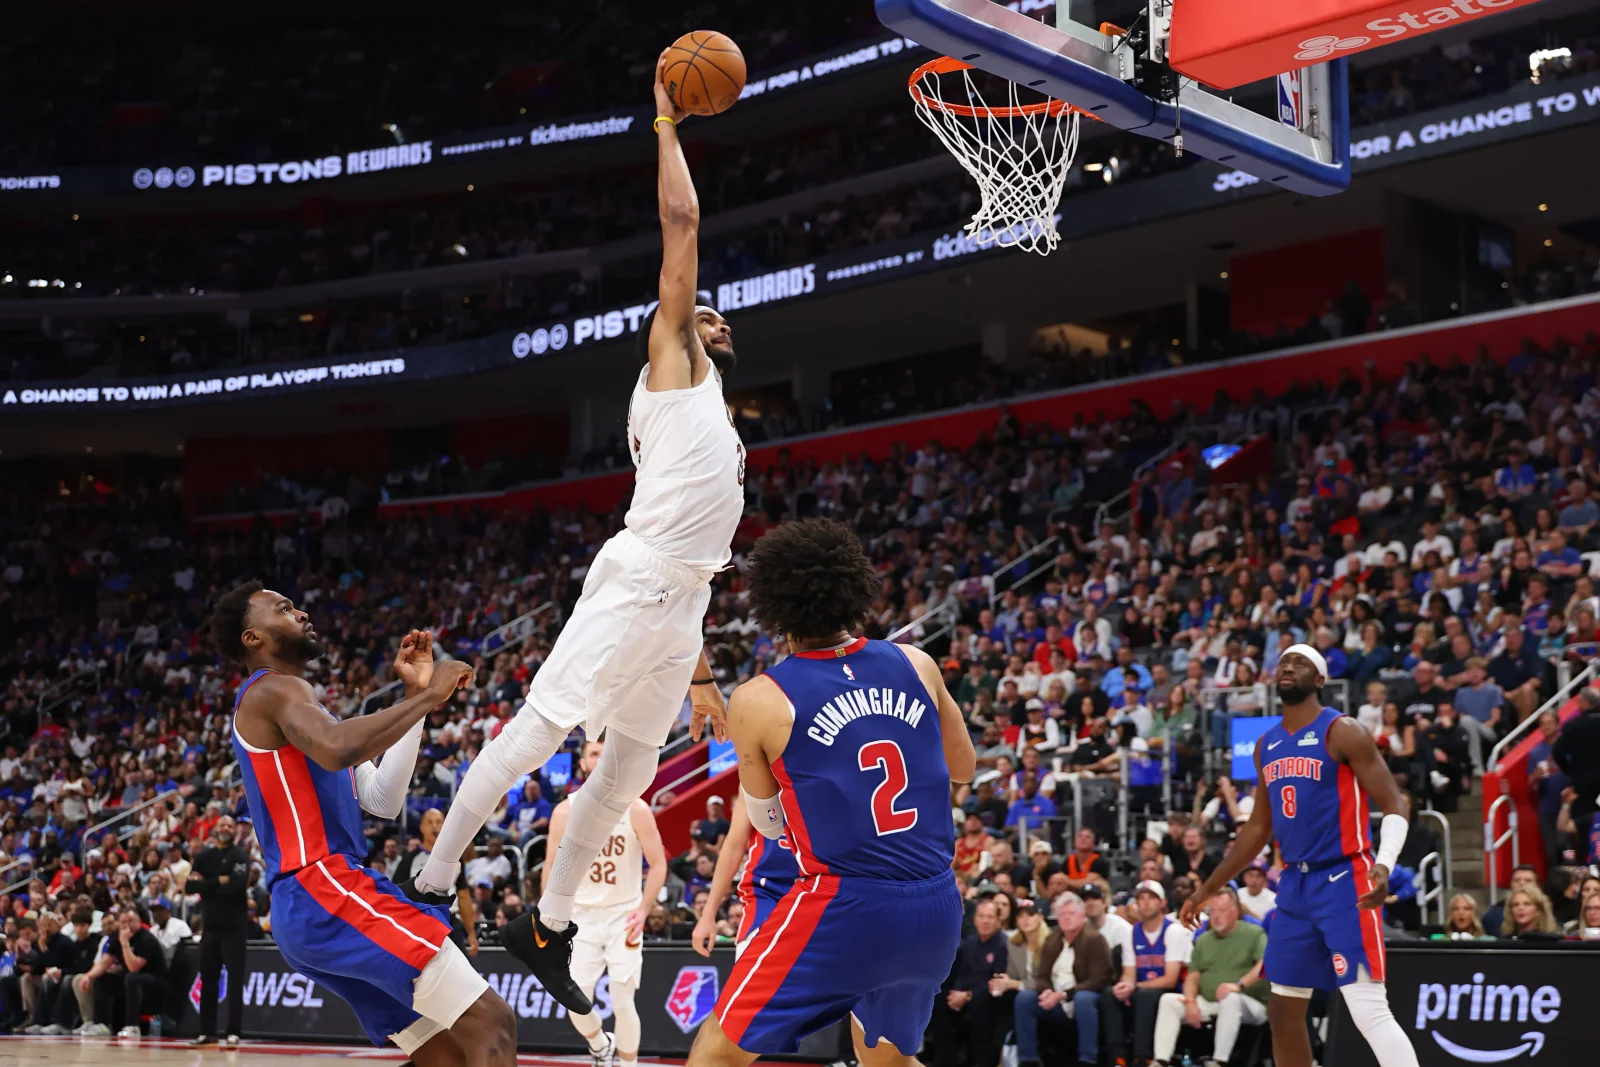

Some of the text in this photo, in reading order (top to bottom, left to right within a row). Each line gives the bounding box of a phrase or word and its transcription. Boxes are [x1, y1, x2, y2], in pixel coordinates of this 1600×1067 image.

[768, 69, 799, 91] FOR
[800, 66, 813, 82] A
[813, 45, 879, 77] CHANCE
[879, 37, 904, 56] TO
[203, 156, 342, 186] PISTONS
[347, 141, 432, 175] REWARDS
[530, 116, 634, 146] ticketmaster
[1350, 135, 1391, 159] OR
[1396, 130, 1416, 150] A
[1419, 101, 1532, 144] CHANCE
[1537, 92, 1577, 116] TO
[717, 263, 816, 312] REWARDS
[827, 255, 903, 281] PRESENTED
[906, 250, 925, 264] BY
[3, 358, 405, 404] A CHANCE TO WIN A PAIR OF PLAYOFF TICKETS
[807, 687, 927, 747] CUNNINGHAM
[857, 739, 919, 837] 2
[1262, 756, 1323, 787] DETROIT
[1281, 785, 1297, 819] 8
[589, 861, 617, 885] 32
[1415, 972, 1562, 1030] prime
